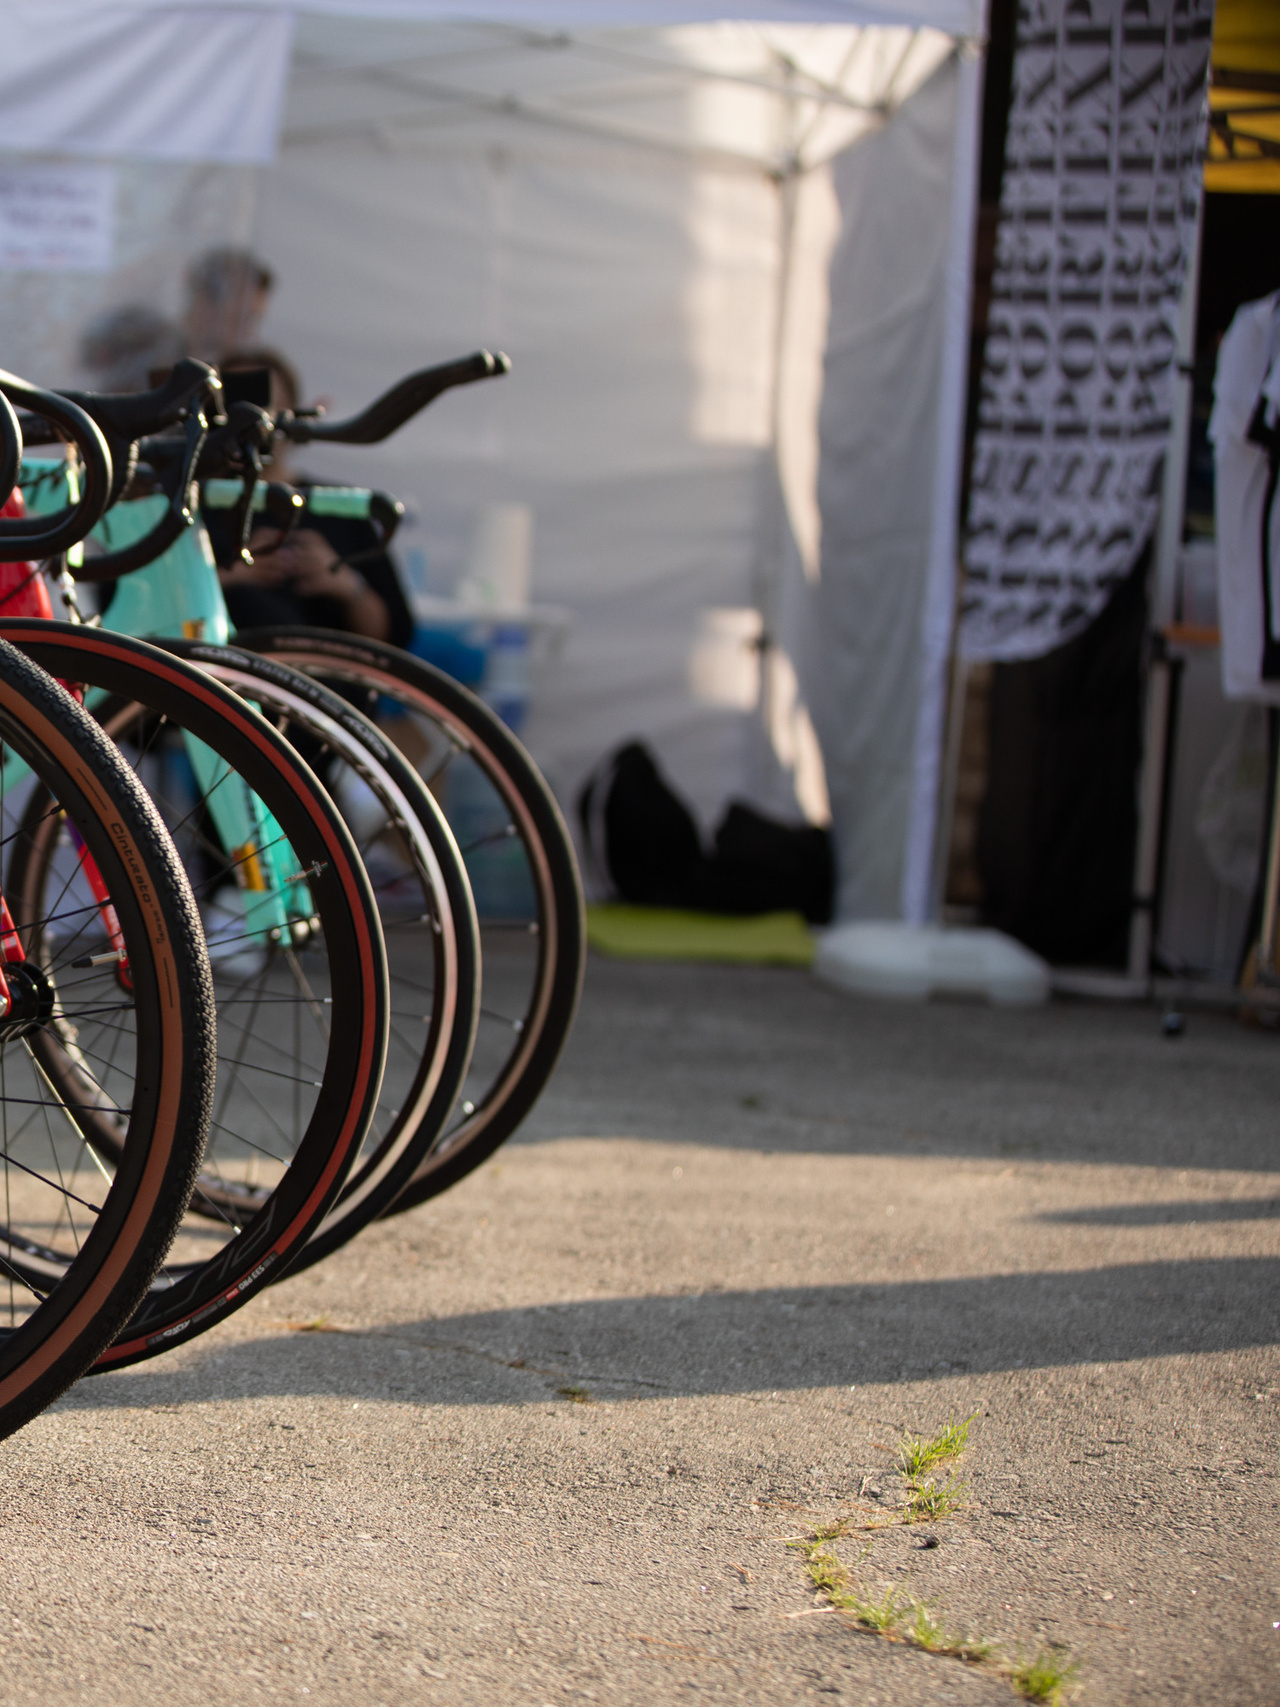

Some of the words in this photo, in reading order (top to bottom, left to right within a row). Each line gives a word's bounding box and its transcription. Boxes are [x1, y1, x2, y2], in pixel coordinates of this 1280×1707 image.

[110, 822, 152, 904] Cinturato
[252, 1265, 266, 1280] S33
[237, 1277, 253, 1291] PRO
